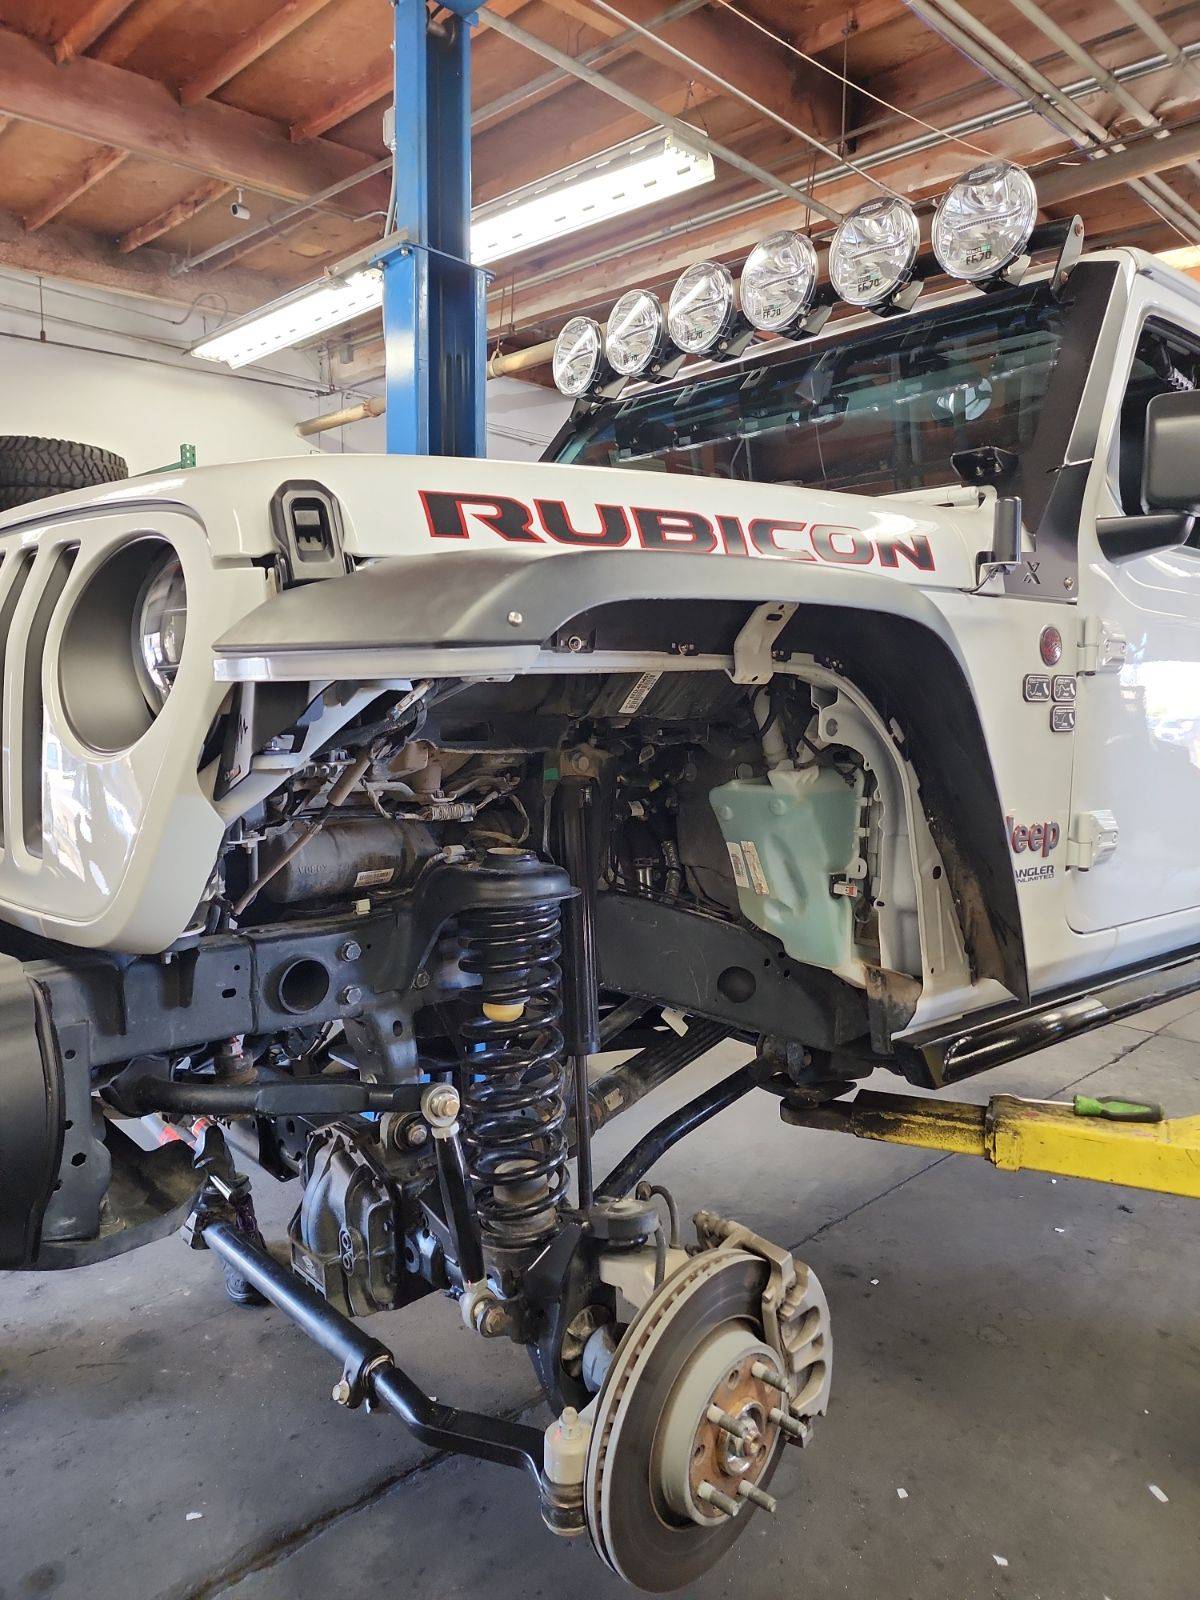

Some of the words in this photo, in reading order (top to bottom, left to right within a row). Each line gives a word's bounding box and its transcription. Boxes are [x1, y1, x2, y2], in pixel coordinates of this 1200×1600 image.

[418, 490, 936, 571] RUBICON
[1015, 865, 1054, 878] NGLER
[1017, 873, 1054, 883] NLIMITED
